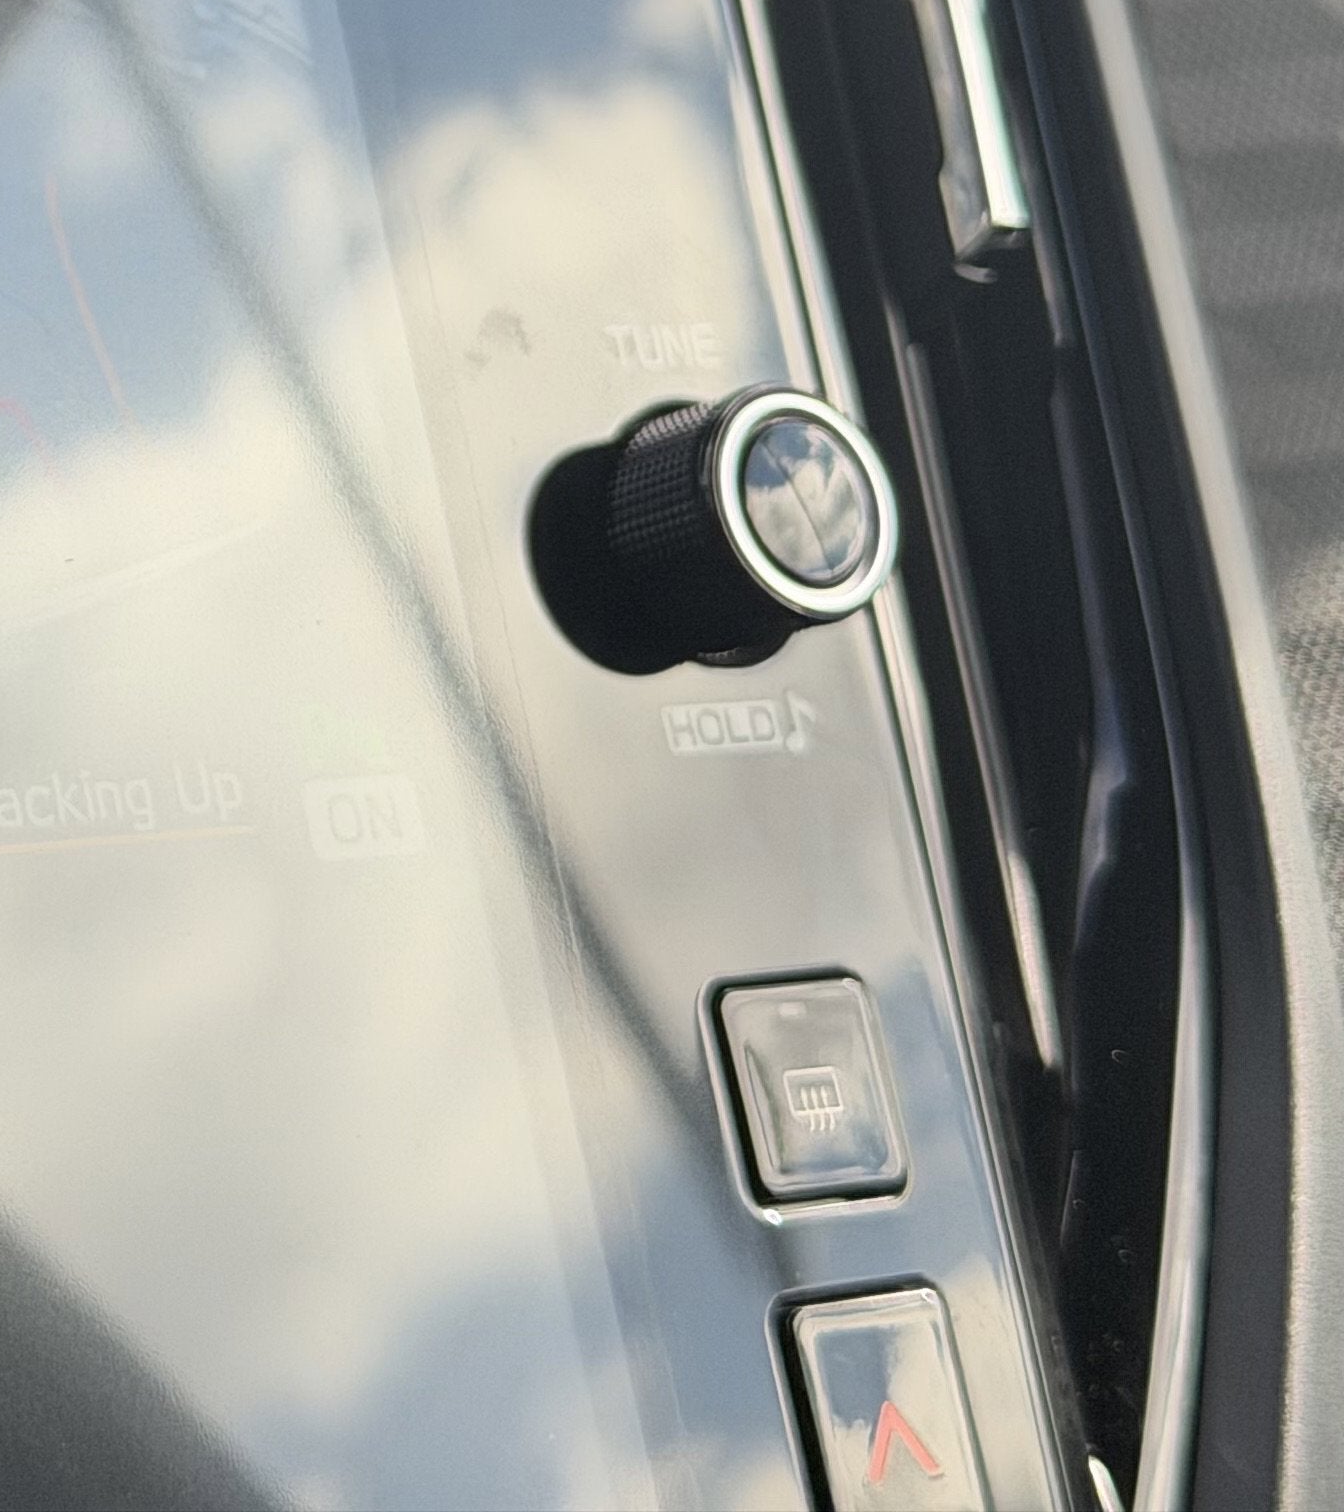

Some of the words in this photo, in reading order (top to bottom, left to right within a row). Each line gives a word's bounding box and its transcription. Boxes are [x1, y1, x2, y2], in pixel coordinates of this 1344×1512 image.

[604, 322, 723, 372] TUNE
[669, 706, 777, 749] HOLD
[175, 758, 244, 821] Up
[325, 791, 406, 846] ON
